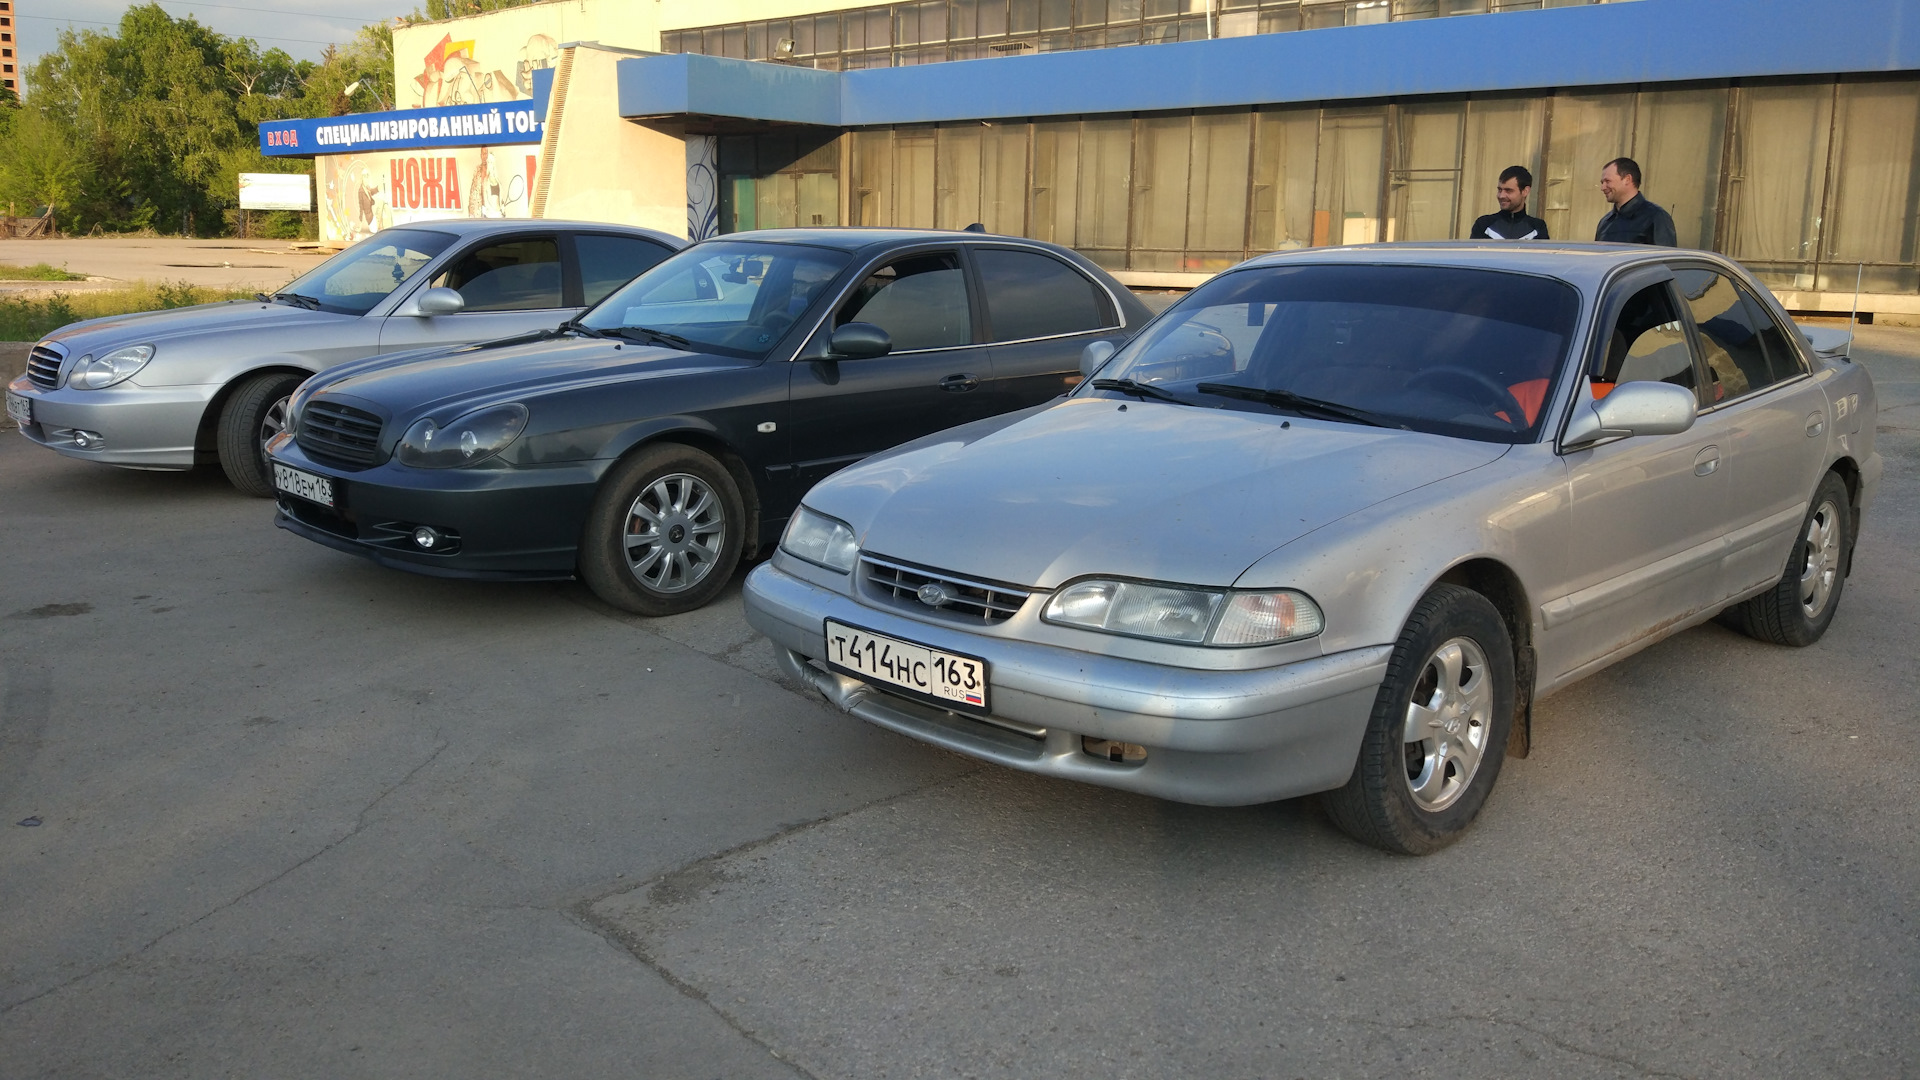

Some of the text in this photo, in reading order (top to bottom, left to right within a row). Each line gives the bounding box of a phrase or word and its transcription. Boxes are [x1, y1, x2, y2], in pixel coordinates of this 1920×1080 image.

[267, 130, 298, 147] ВХОД
[316, 108, 544, 146] СПЕЦИАЛИЗИРОВАННЫЙ ТОР
[390, 157, 462, 209] КОЖА
[934, 657, 976, 690] 163
[944, 686, 965, 700] RUS
